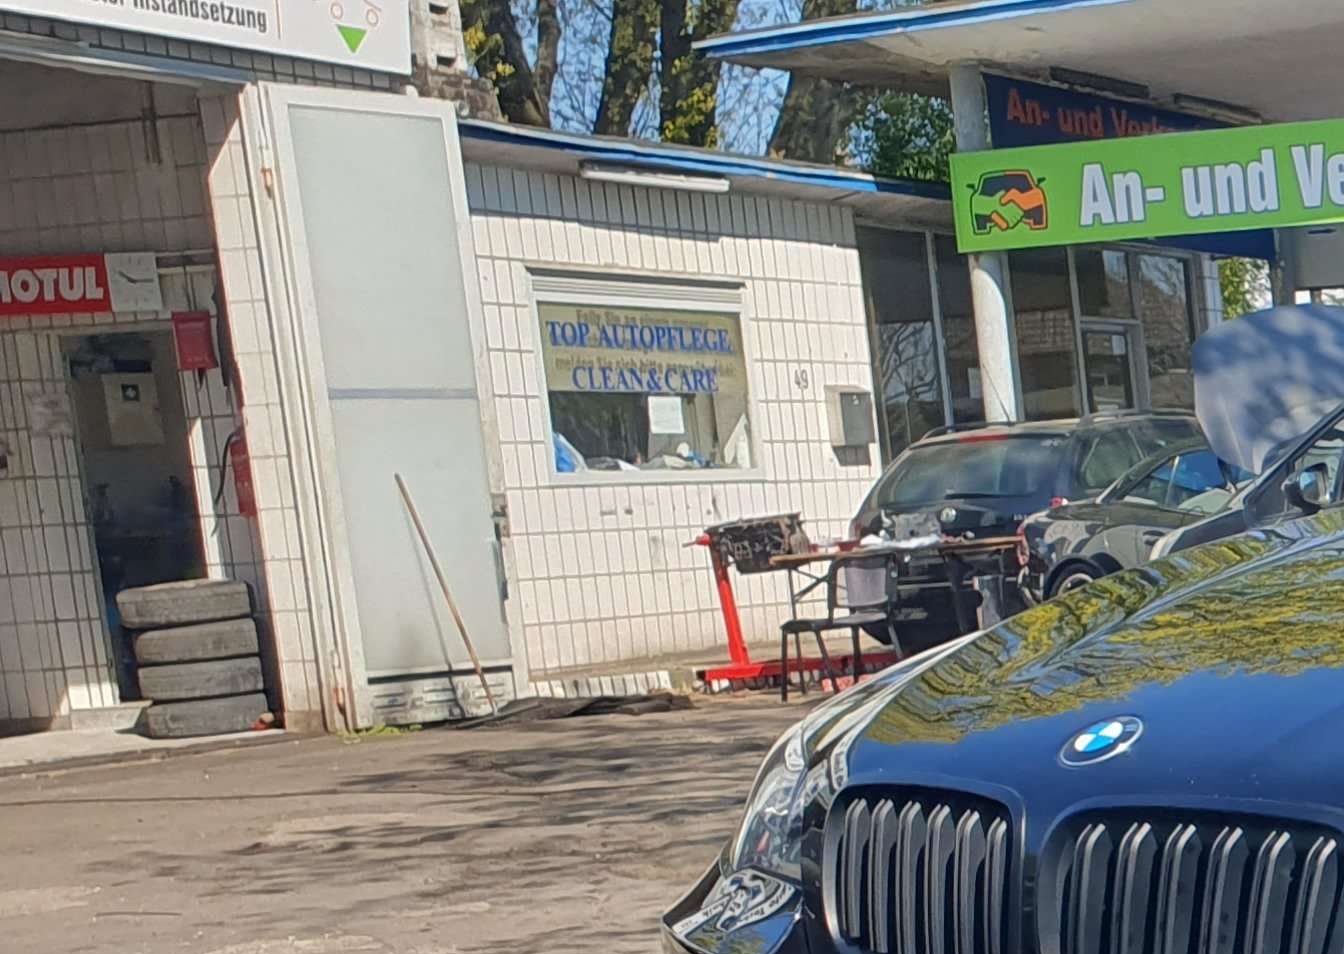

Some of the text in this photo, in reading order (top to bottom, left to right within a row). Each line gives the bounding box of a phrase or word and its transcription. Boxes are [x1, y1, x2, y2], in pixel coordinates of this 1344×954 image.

[1007, 88, 1049, 126] An-
[1058, 103, 1104, 138] und
[1078, 162, 1165, 227] An-
[1180, 147, 1280, 219] und
[547, 320, 590, 348] TOP
[599, 321, 731, 353] AUTOPFLEGE
